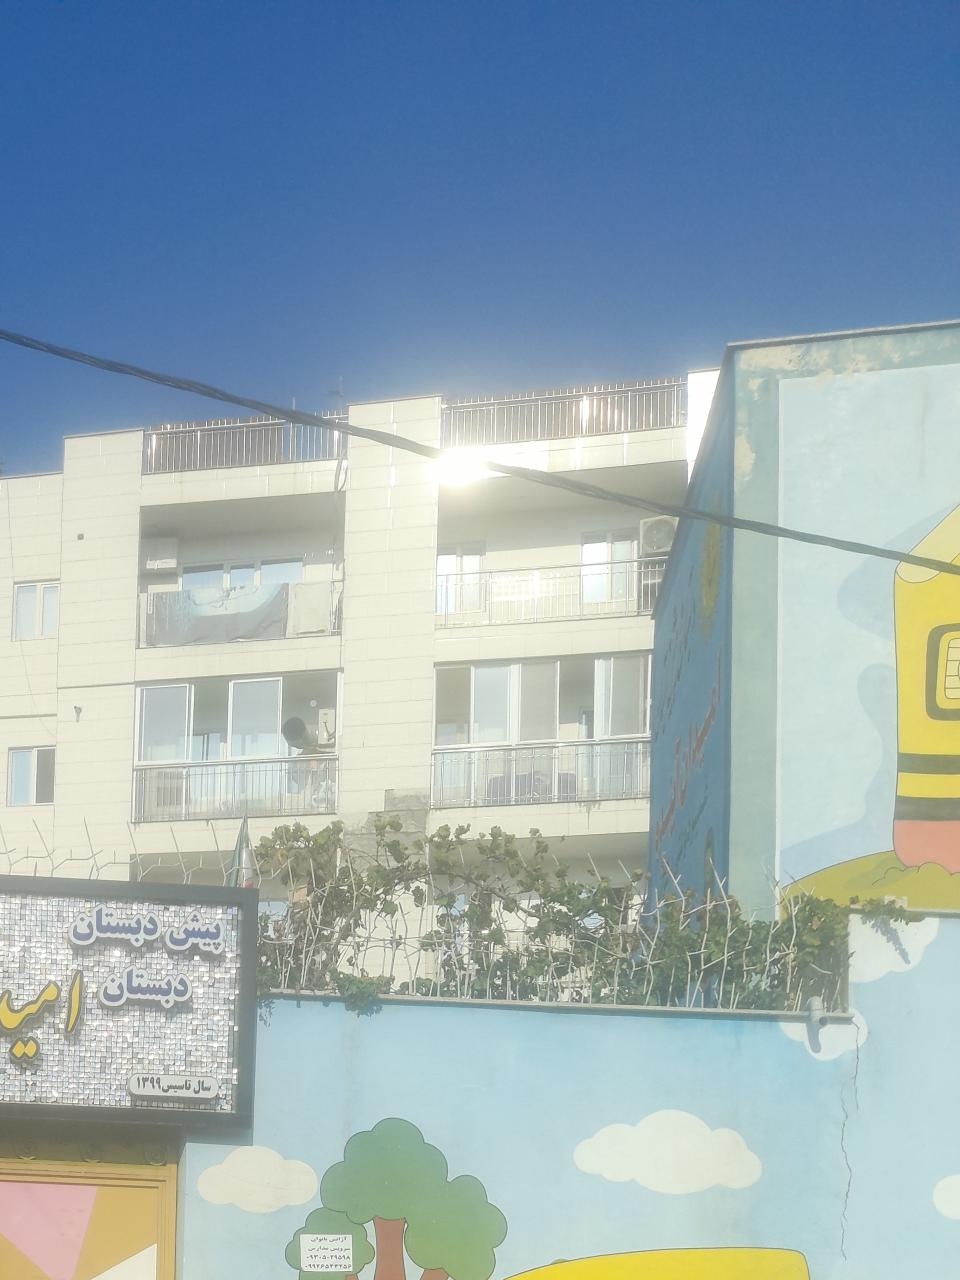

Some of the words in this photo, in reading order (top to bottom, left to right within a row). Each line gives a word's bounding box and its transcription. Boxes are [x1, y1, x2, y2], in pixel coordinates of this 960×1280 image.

[70, 904, 160, 945] دبستان
[167, 912, 223, 952] پیش
[100, 965, 190, 1006] دبستان
[193, 1079, 212, 1094] سال
